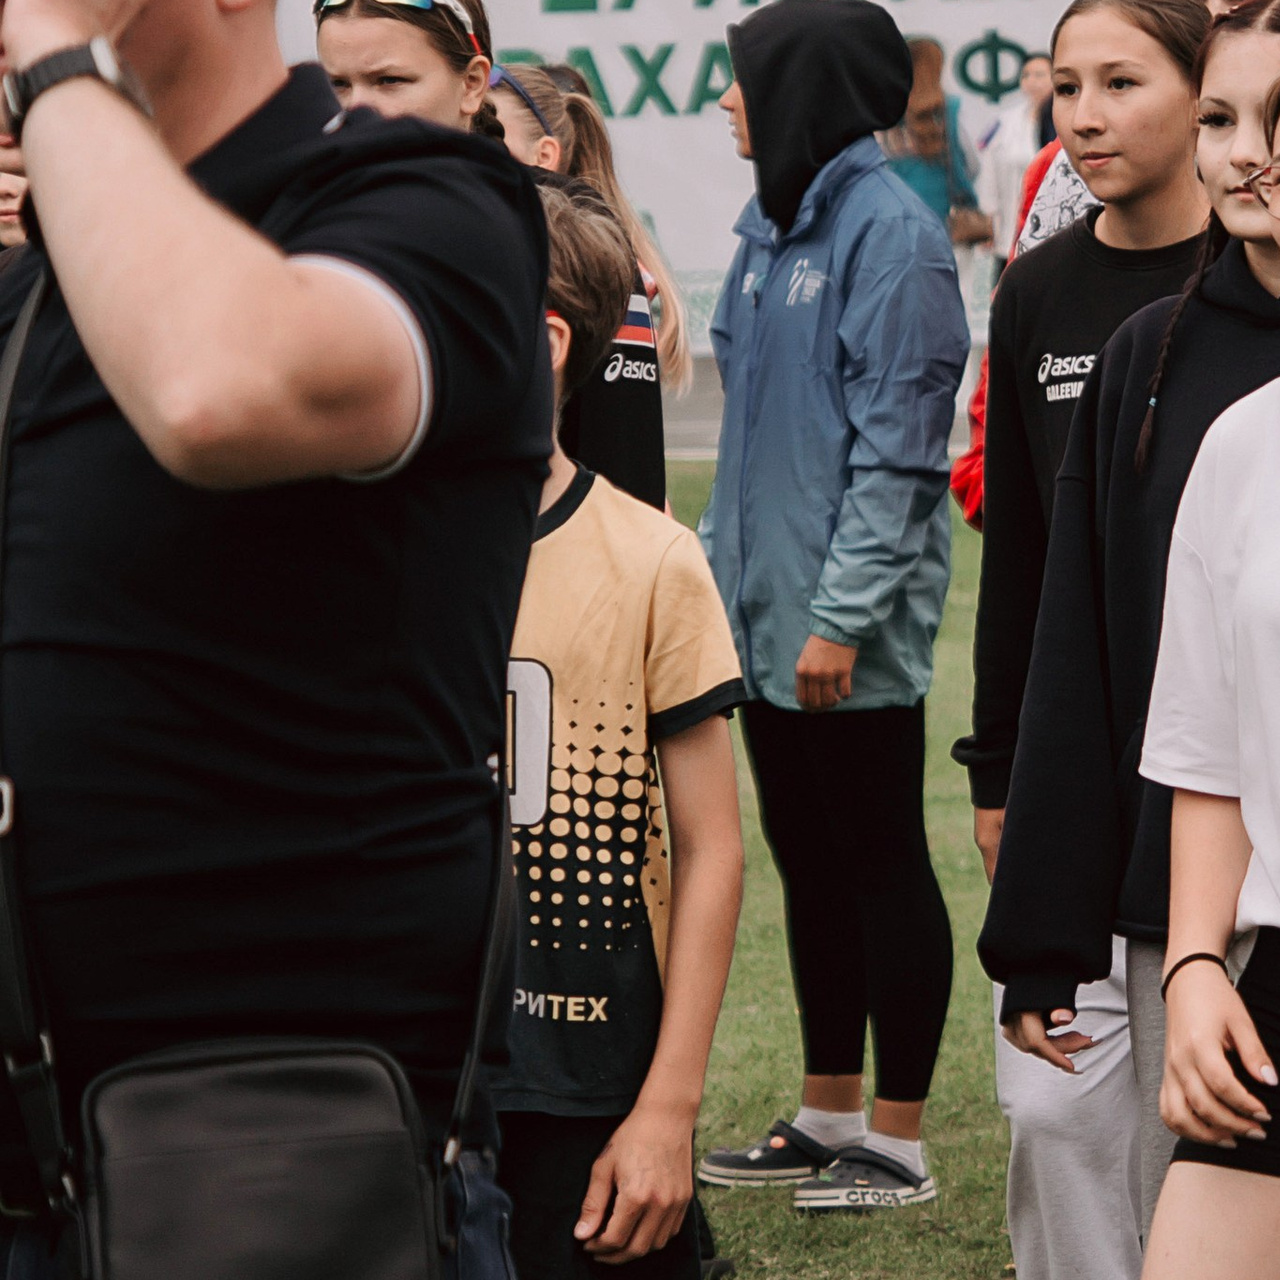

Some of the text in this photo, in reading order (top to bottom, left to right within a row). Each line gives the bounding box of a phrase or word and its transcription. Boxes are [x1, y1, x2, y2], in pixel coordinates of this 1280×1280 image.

[622, 359, 657, 382] asics
[1050, 354, 1096, 377] asics
[845, 1188, 901, 1206] crocs
